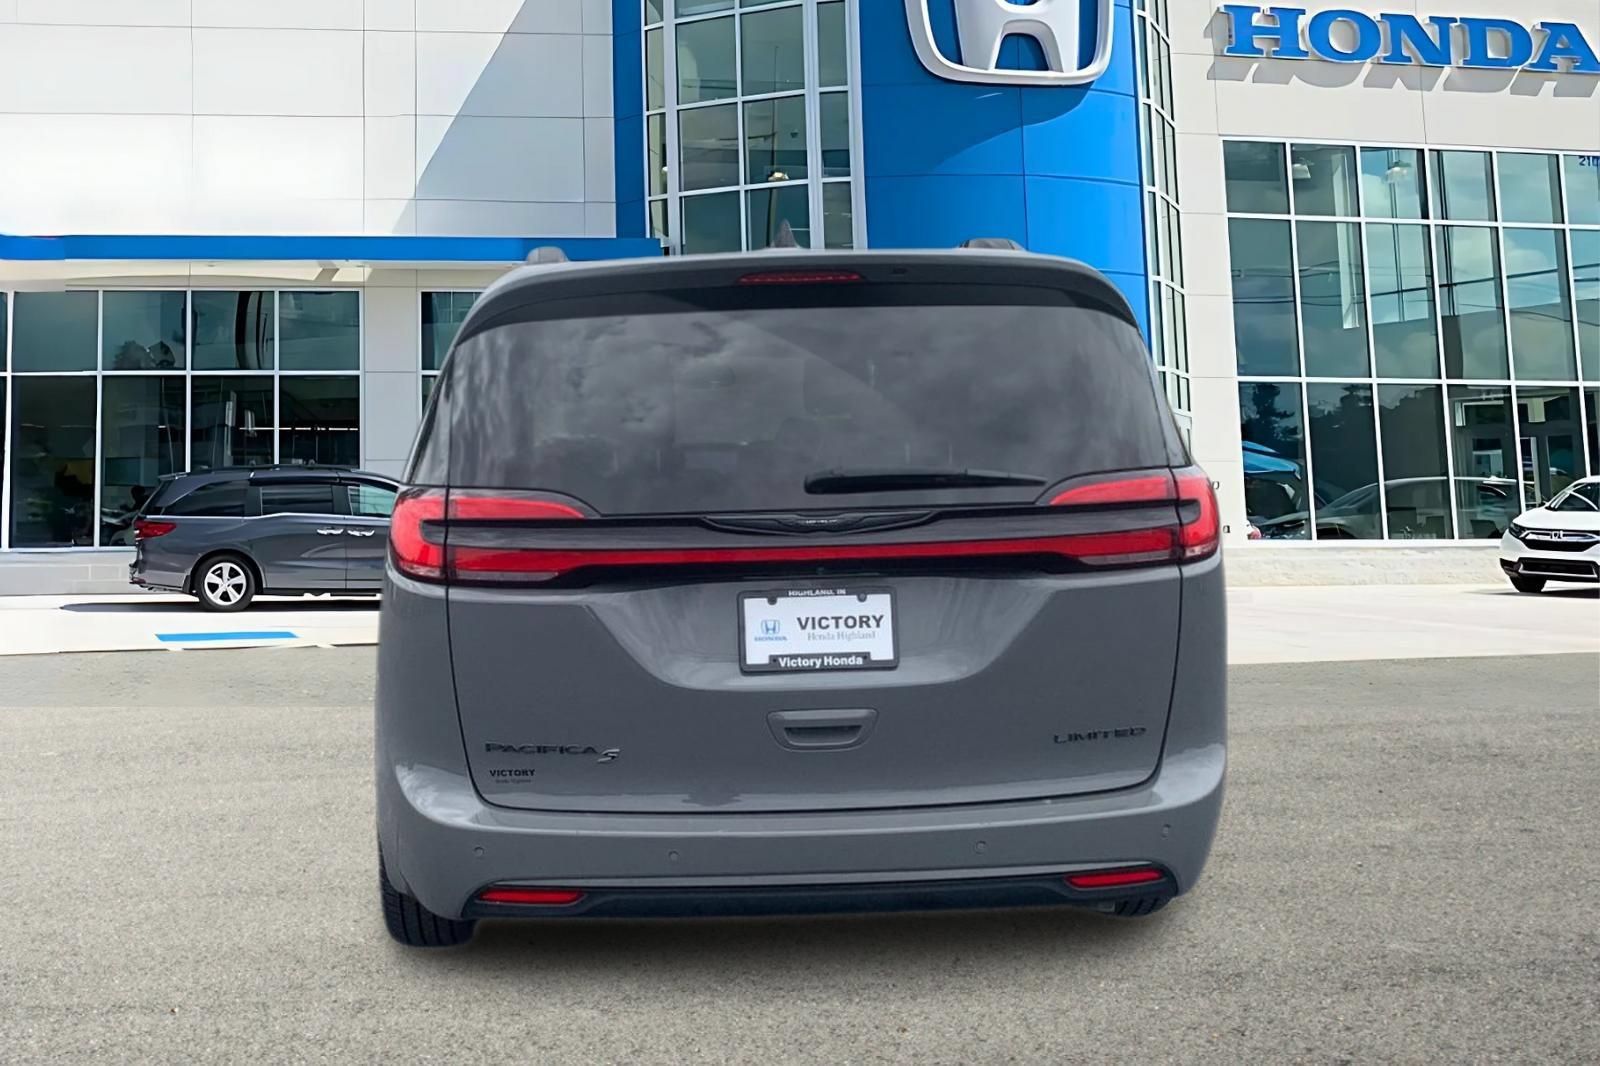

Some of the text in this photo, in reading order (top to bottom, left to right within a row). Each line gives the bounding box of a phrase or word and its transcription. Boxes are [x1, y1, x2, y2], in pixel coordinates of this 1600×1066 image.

[1223, 4, 1600, 75] HONDA
[796, 614, 884, 631] VICTORY
[807, 630, 876, 643] Honda Highland
[778, 655, 864, 669] Victory Honda
[1053, 727, 1147, 744] LIMITED
[484, 742, 598, 755] PACIFICA
[489, 768, 536, 778] VICTORY
